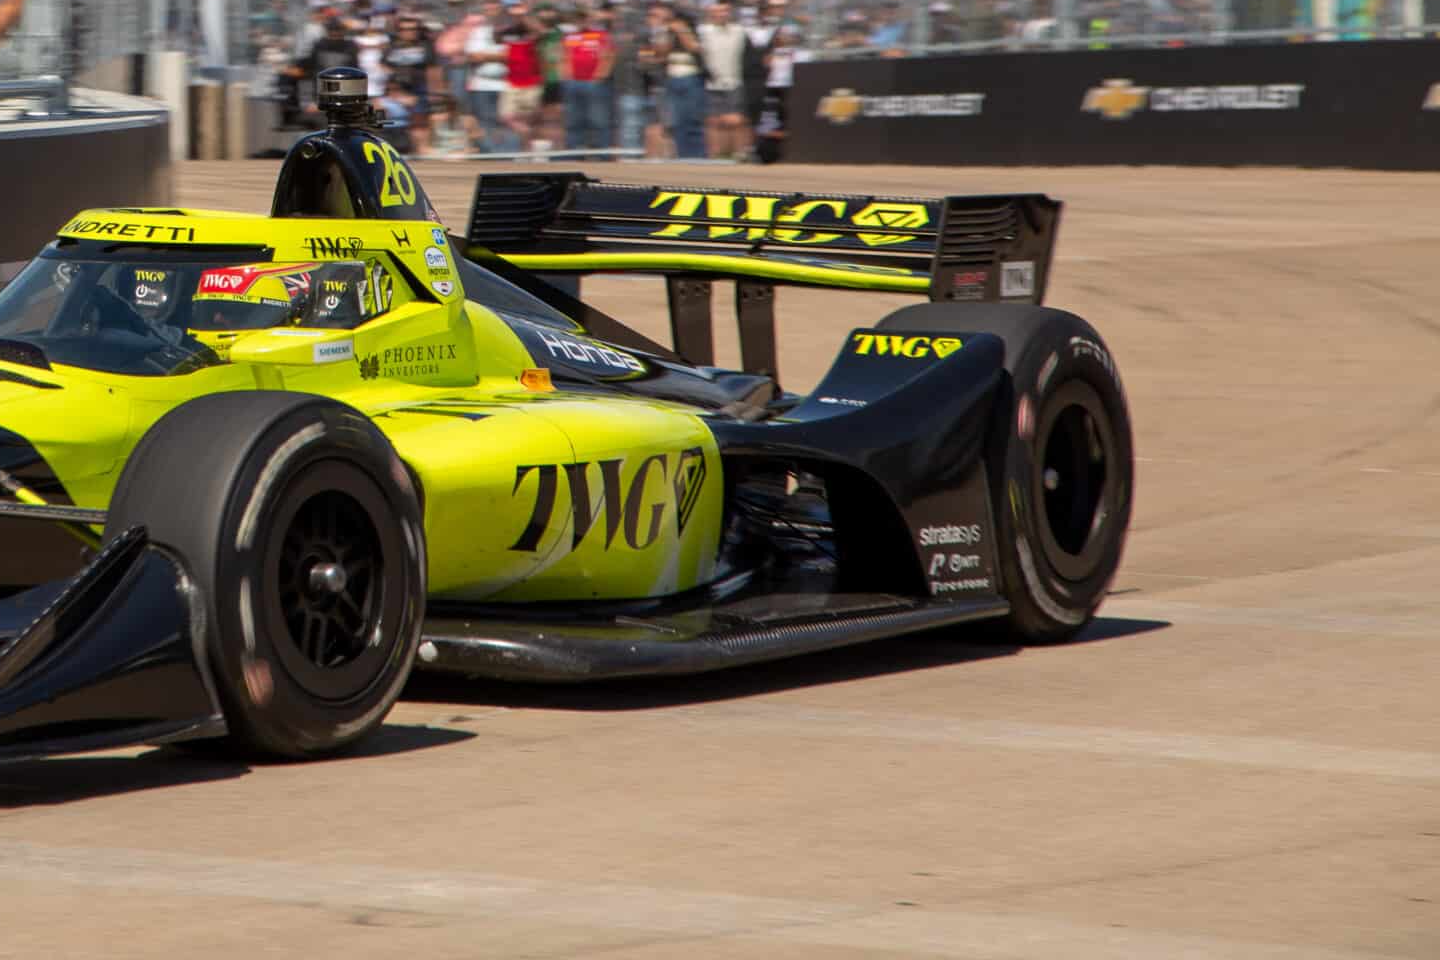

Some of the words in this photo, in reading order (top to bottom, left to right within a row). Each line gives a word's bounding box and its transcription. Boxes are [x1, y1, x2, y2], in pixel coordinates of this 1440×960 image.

[363, 141, 416, 207] 26
[649, 191, 848, 244] TWG
[383, 344, 458, 364] PHOENIX
[853, 334, 931, 358] TWG
[383, 364, 440, 378] INVESTORS
[507, 454, 668, 552] TWG
